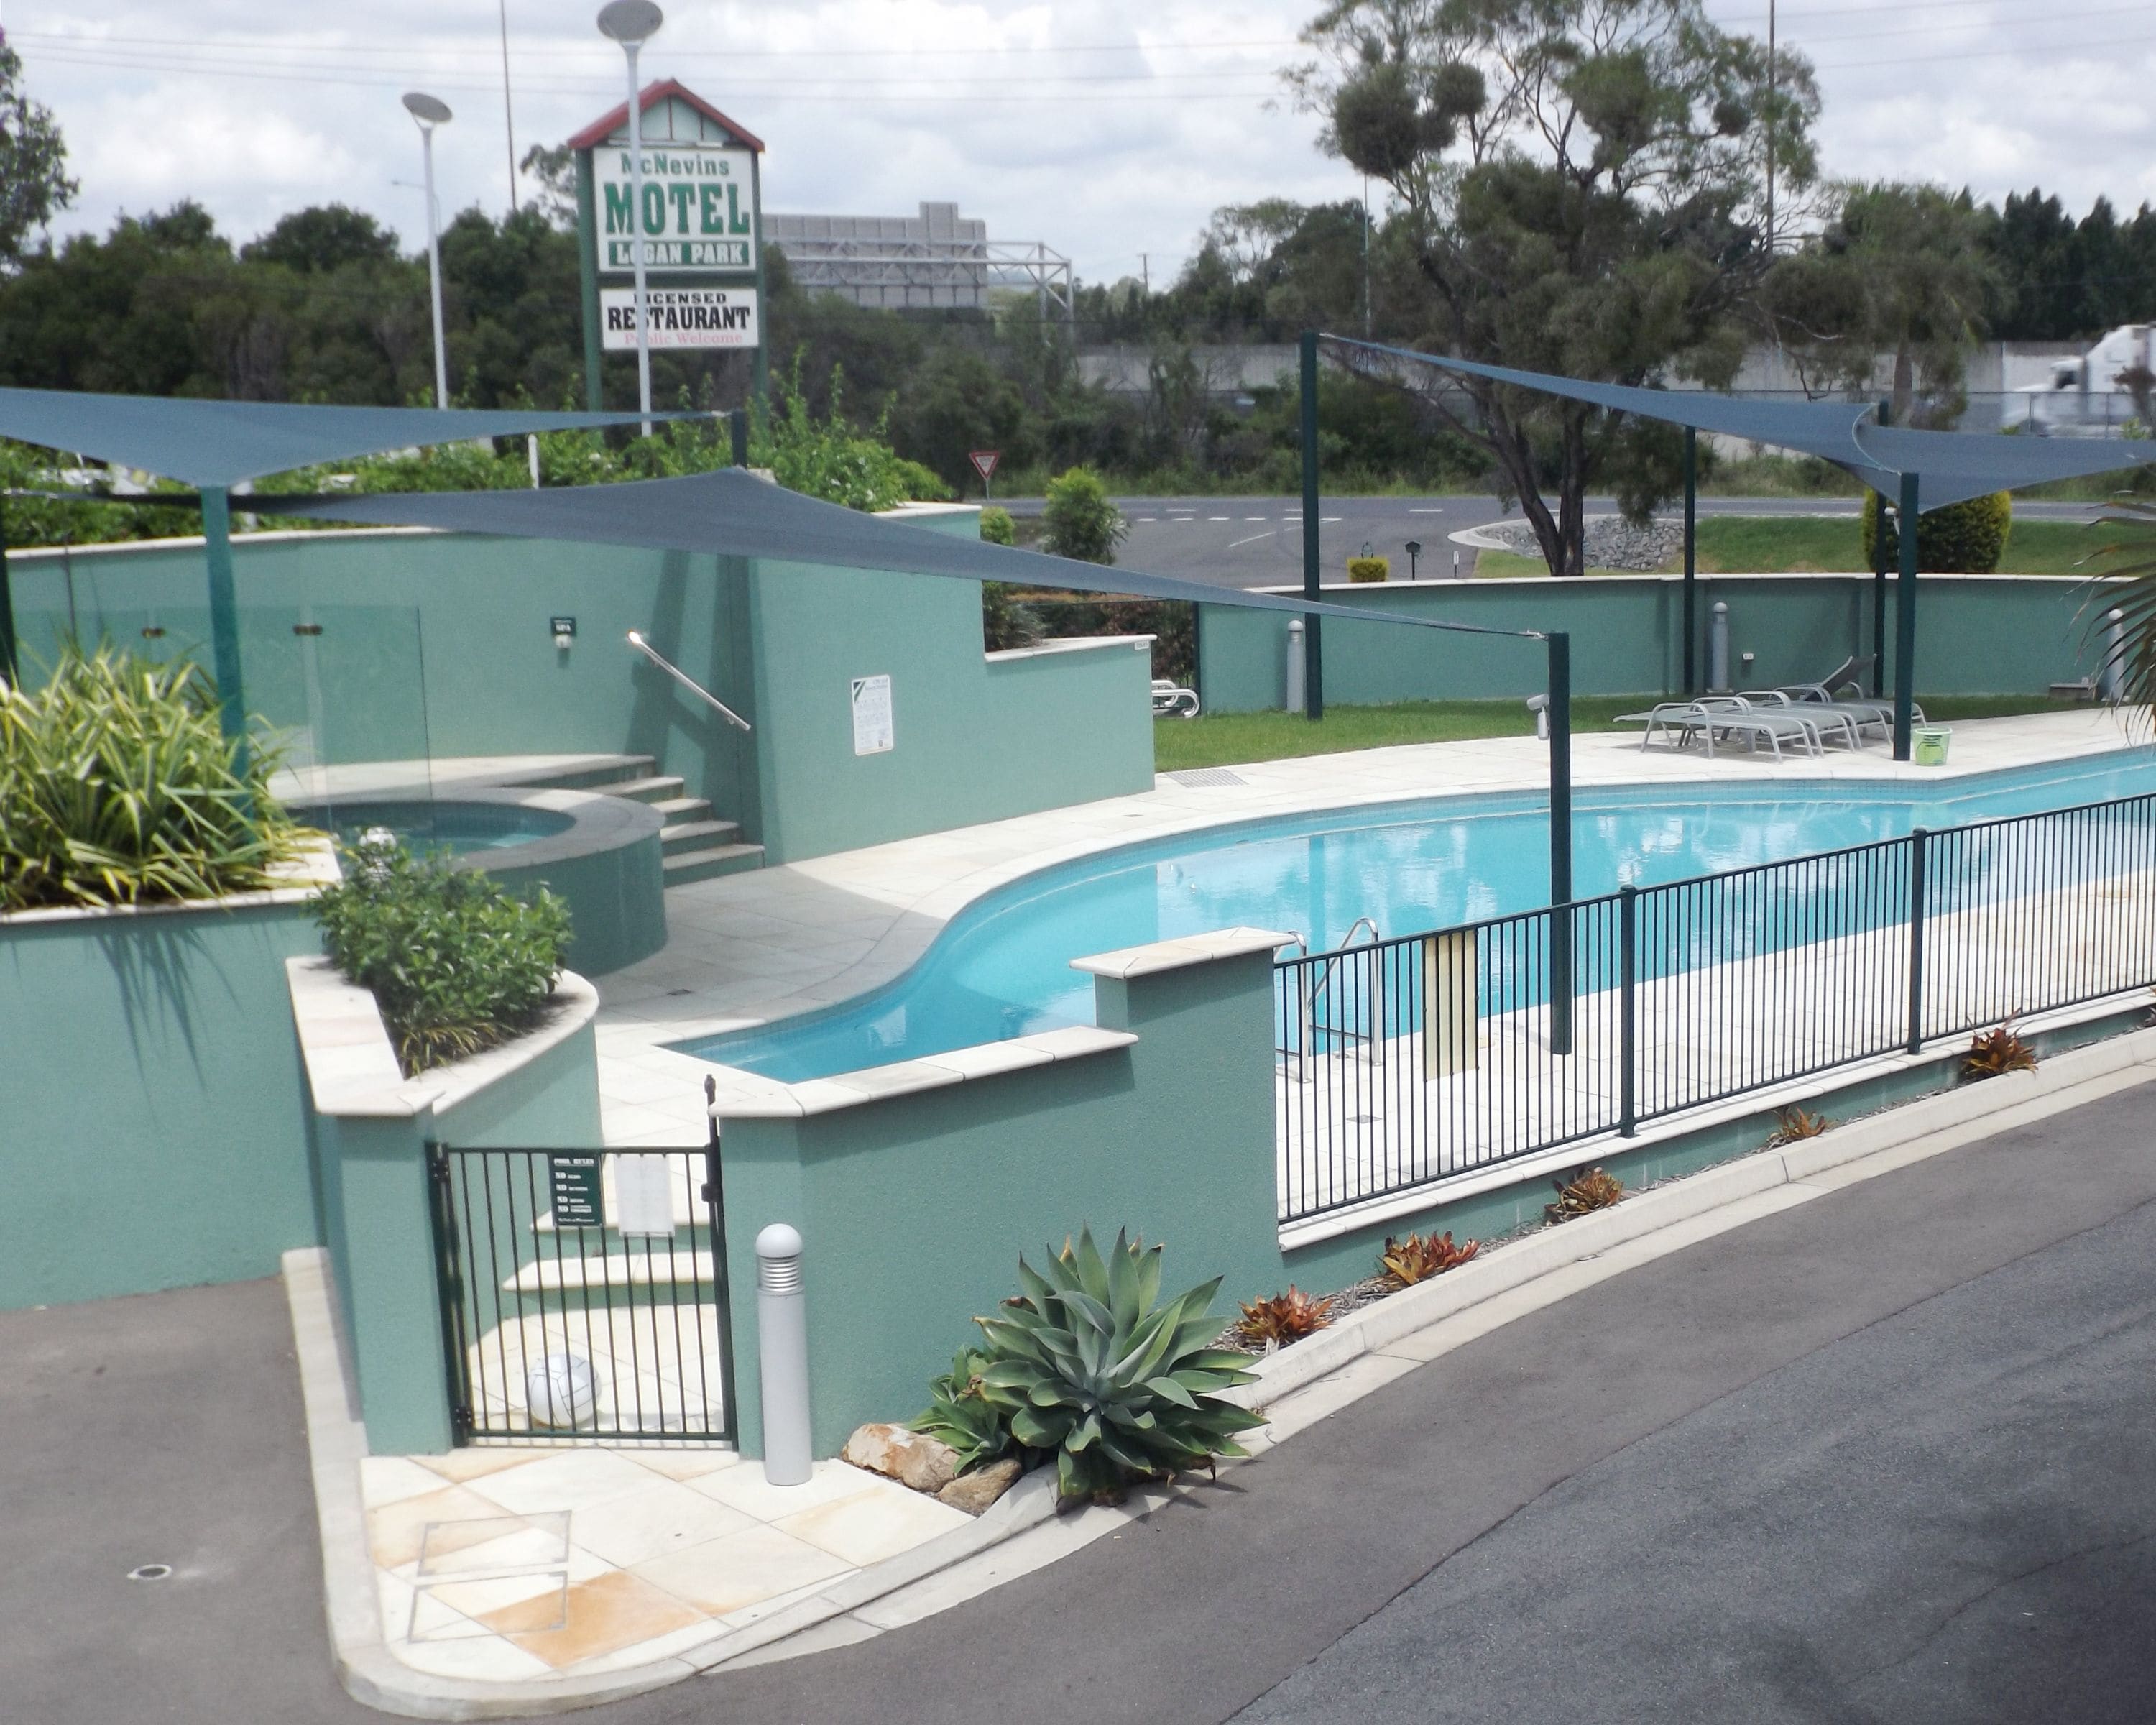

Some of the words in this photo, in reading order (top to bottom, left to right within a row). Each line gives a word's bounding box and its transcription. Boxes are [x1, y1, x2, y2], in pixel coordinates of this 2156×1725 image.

[604, 183, 750, 235] MOTEL
[691, 242, 743, 264] PARK
[634, 293, 726, 304] ICENSED
[607, 306, 750, 330] RETAURANT
[676, 332, 743, 345] Welcome
